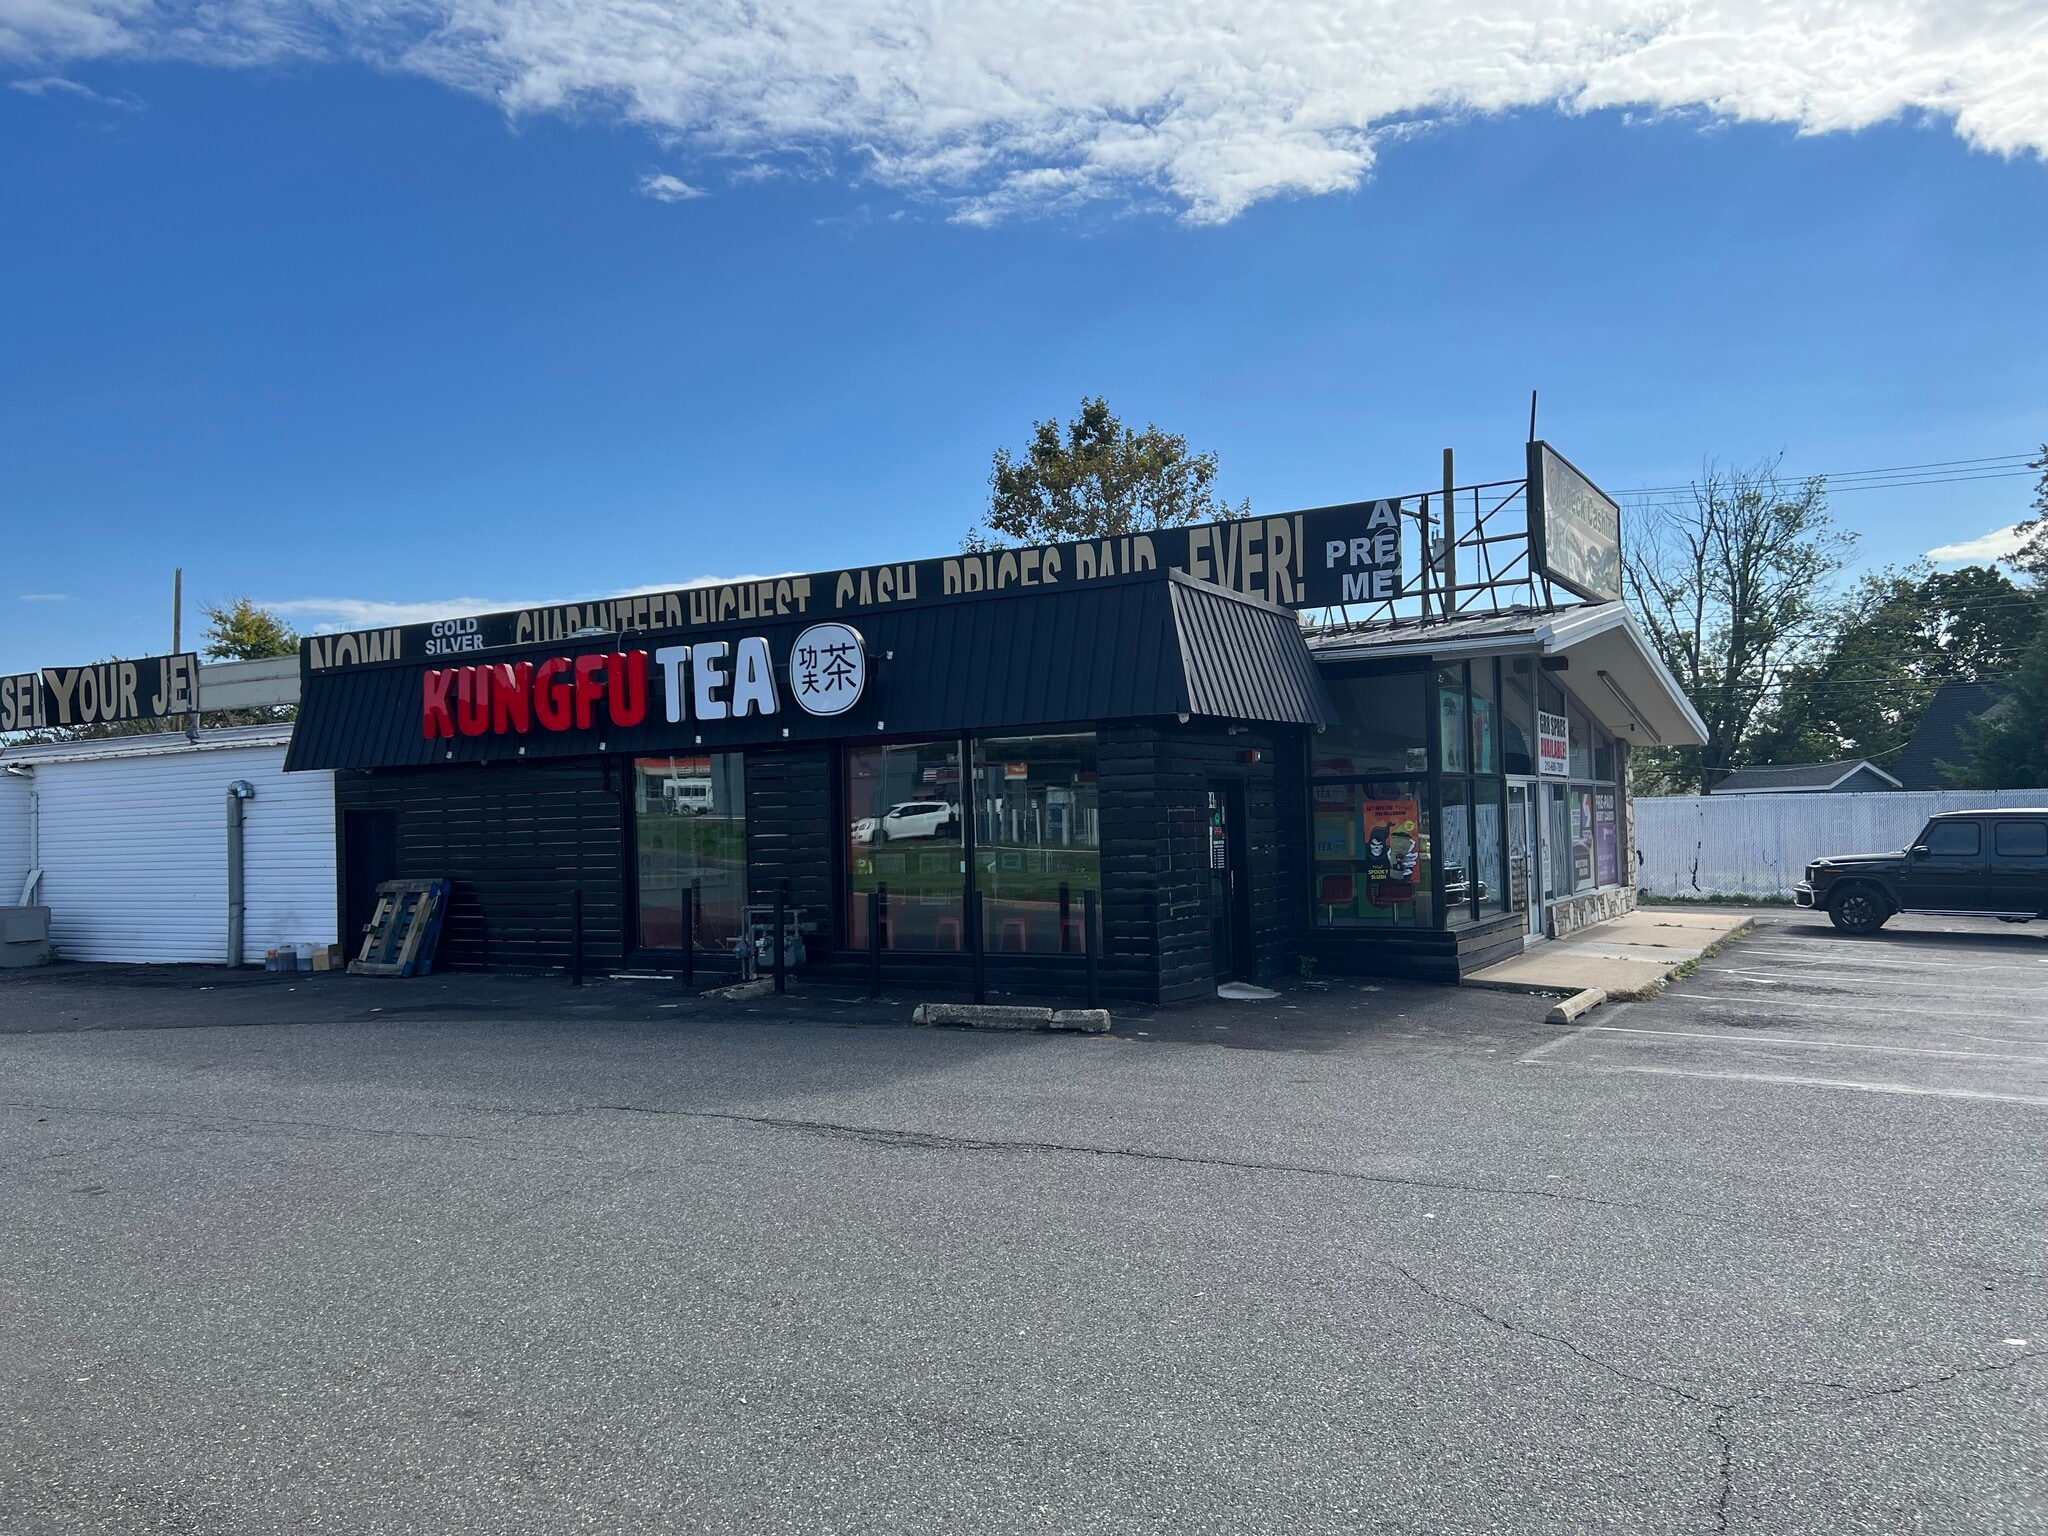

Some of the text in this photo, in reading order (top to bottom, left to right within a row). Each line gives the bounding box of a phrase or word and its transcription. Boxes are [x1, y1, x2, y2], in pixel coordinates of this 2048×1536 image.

[1366, 499, 1398, 530] A
[1188, 514, 1305, 605] EVER!
[1326, 533, 1396, 569] PRE
[1342, 569, 1394, 602] ME
[425, 634, 485, 655] SILVER
[431, 617, 478, 638] GOLD
[43, 662, 138, 724] YOUR
[655, 636, 781, 723] TEA
